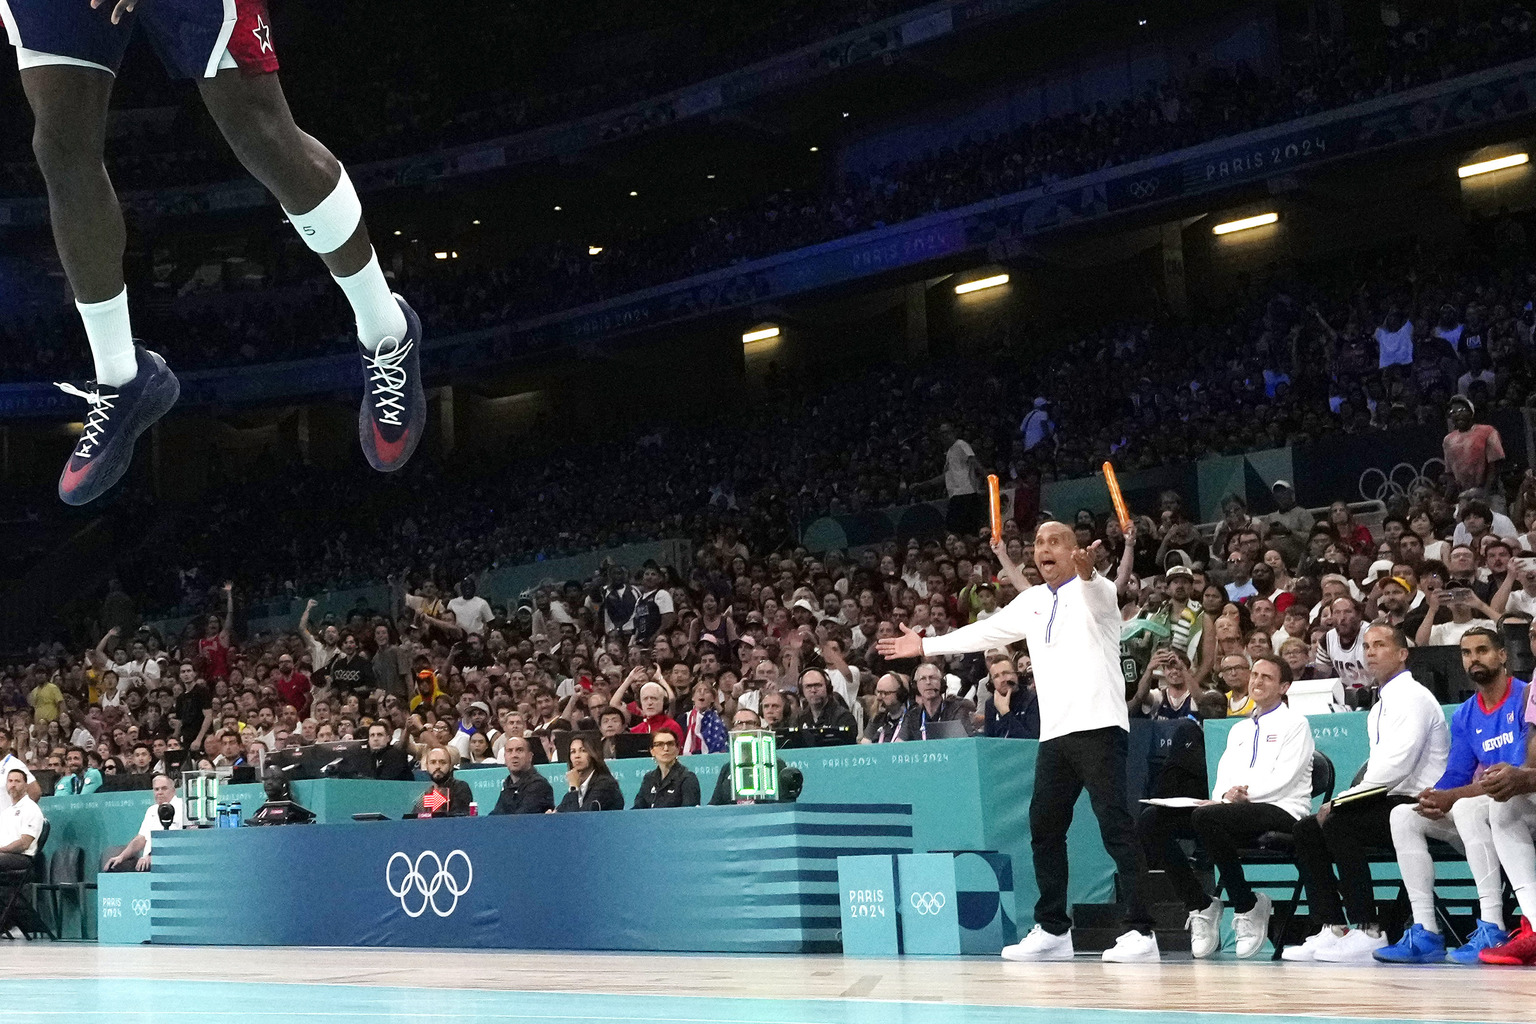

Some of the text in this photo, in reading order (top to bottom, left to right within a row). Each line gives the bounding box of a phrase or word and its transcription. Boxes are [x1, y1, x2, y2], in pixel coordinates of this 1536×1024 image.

[1206, 137, 1326, 180] PARIS 2024
[302, 225, 316, 236] 5
[1315, 728, 1348, 738] 2024
[823, 757, 877, 768] PARIS 2024
[891, 753, 948, 764] PARIS 2024
[849, 889, 884, 903] PARIS
[850, 904, 885, 918] 2024
